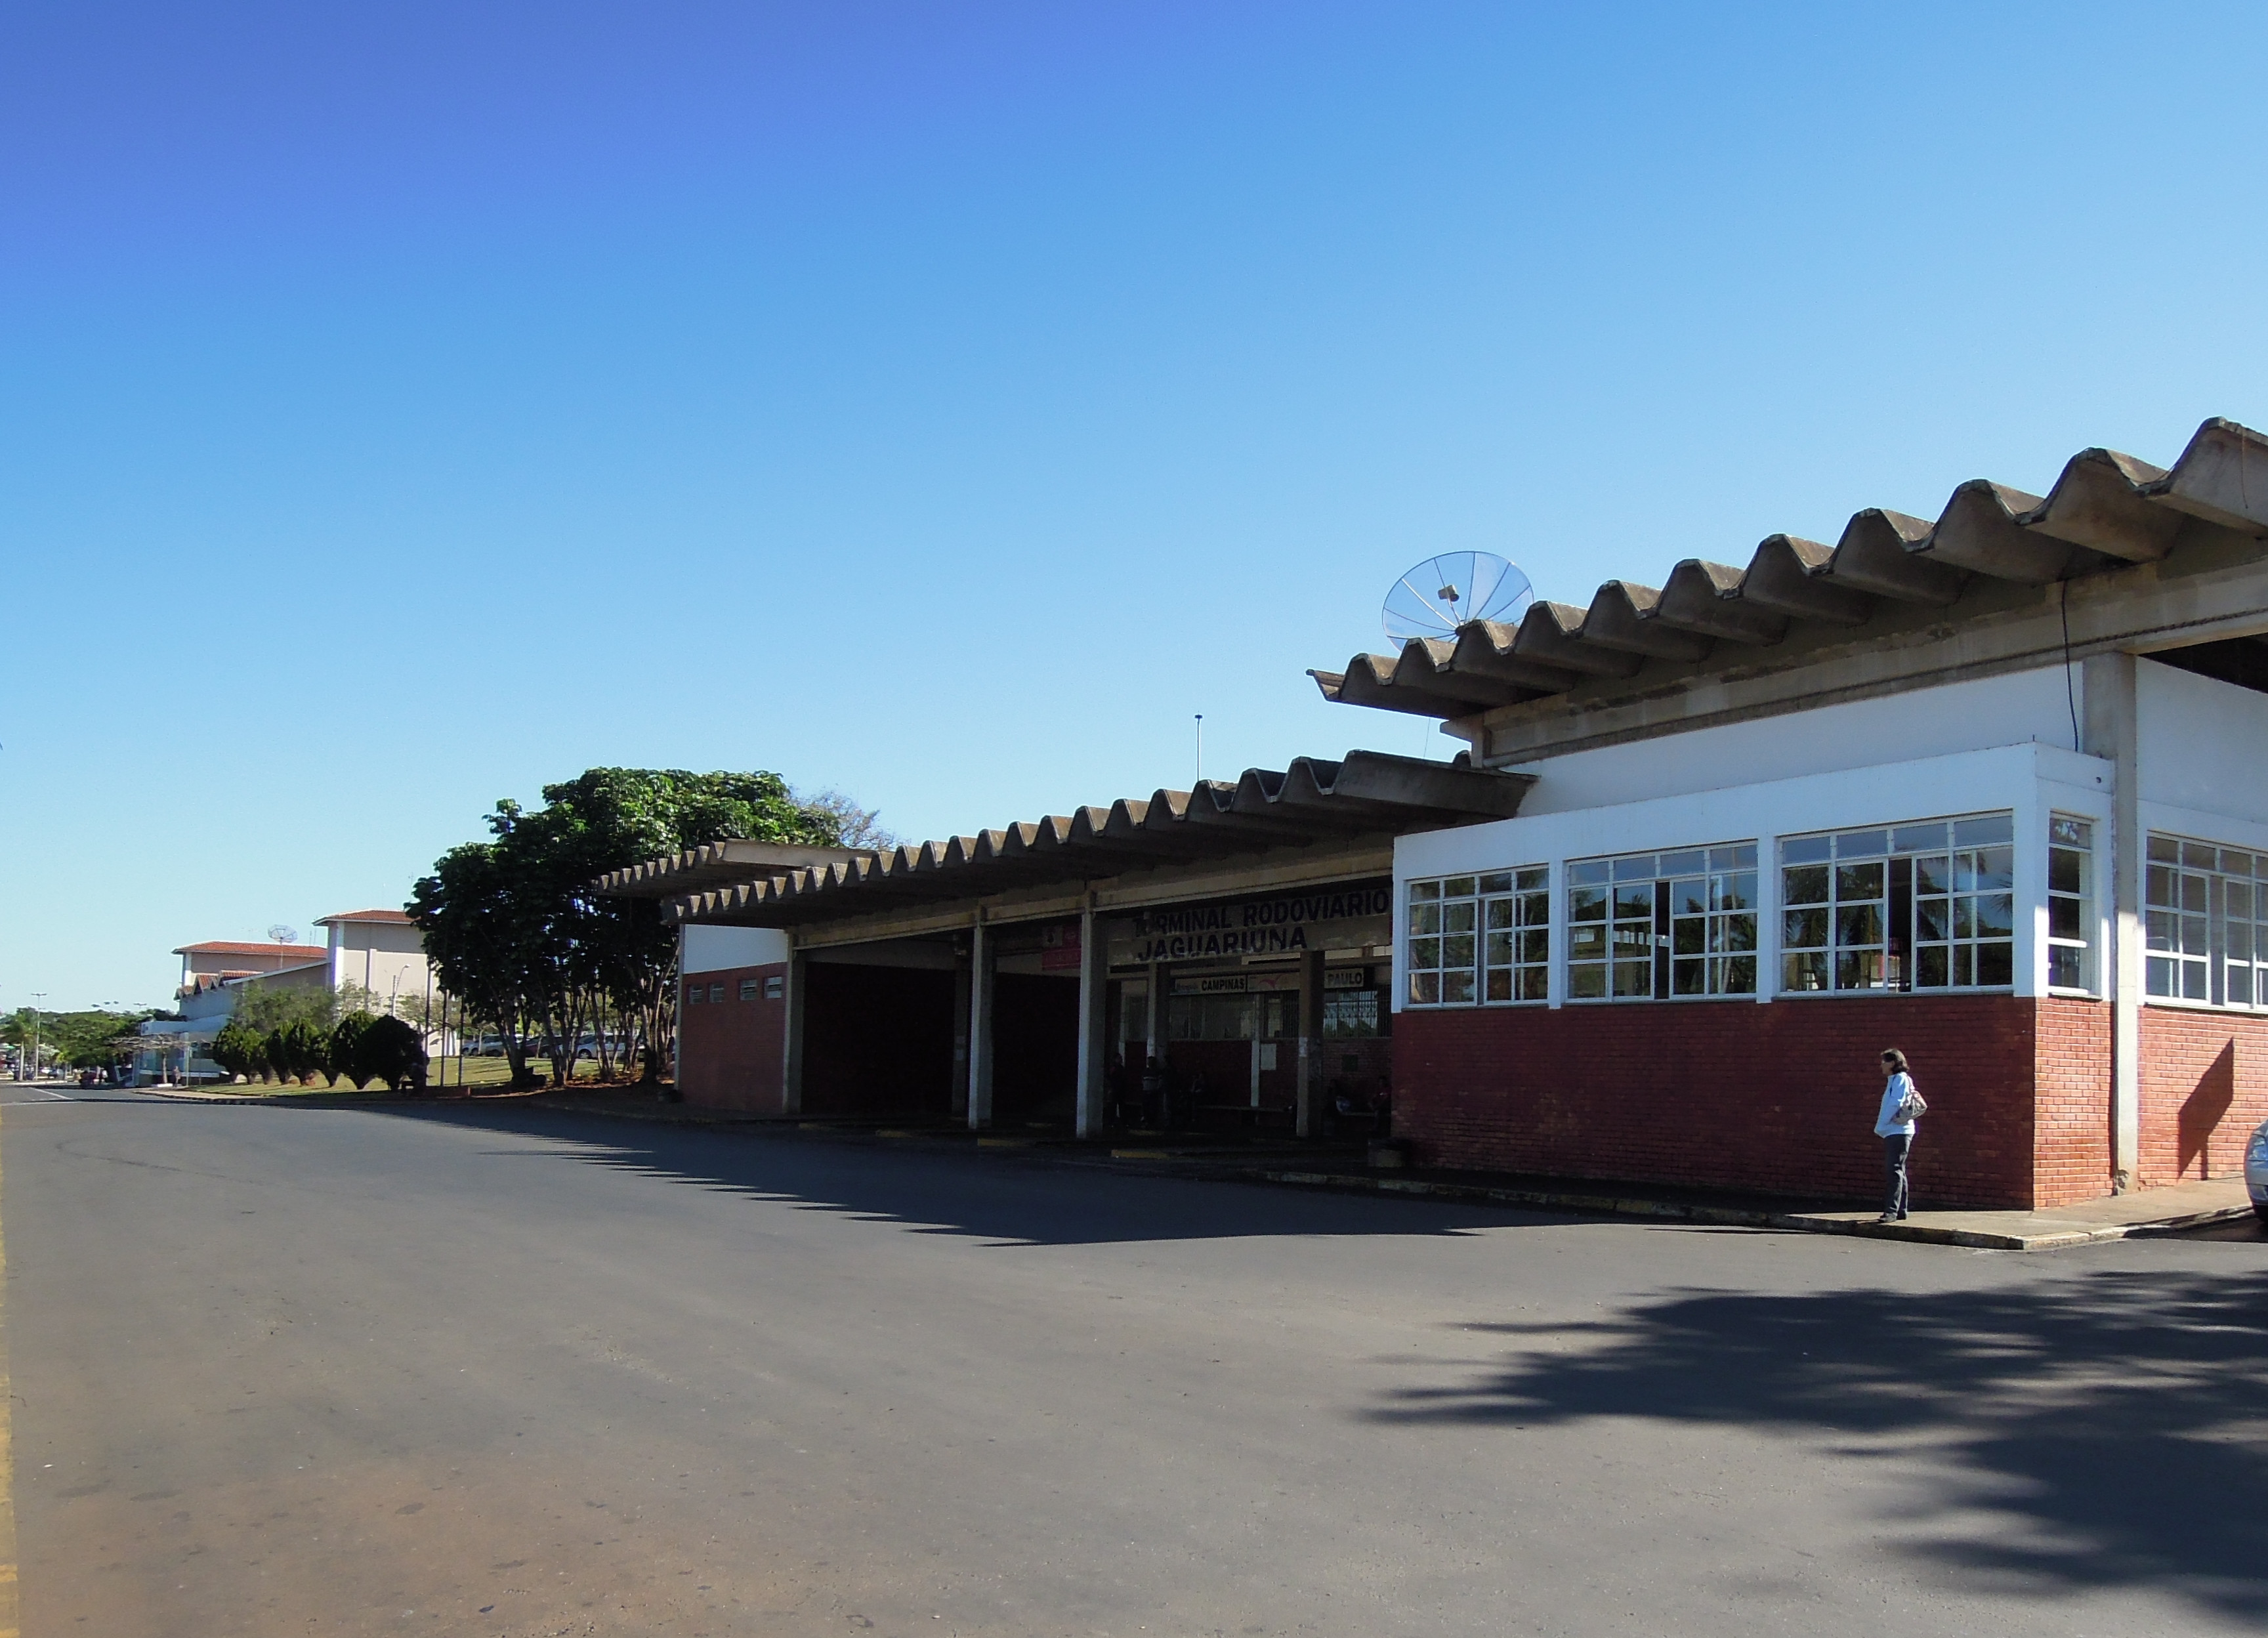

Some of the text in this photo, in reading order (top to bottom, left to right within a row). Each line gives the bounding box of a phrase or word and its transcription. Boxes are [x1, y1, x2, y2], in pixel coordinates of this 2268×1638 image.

[1132, 890, 1389, 937] TRMINAL RODOVIARIO
[1138, 927, 1307, 961] JAGUARIUNA
[1202, 978, 1244, 991] CAMPINAS
[1328, 973, 1362, 986] PAULO
